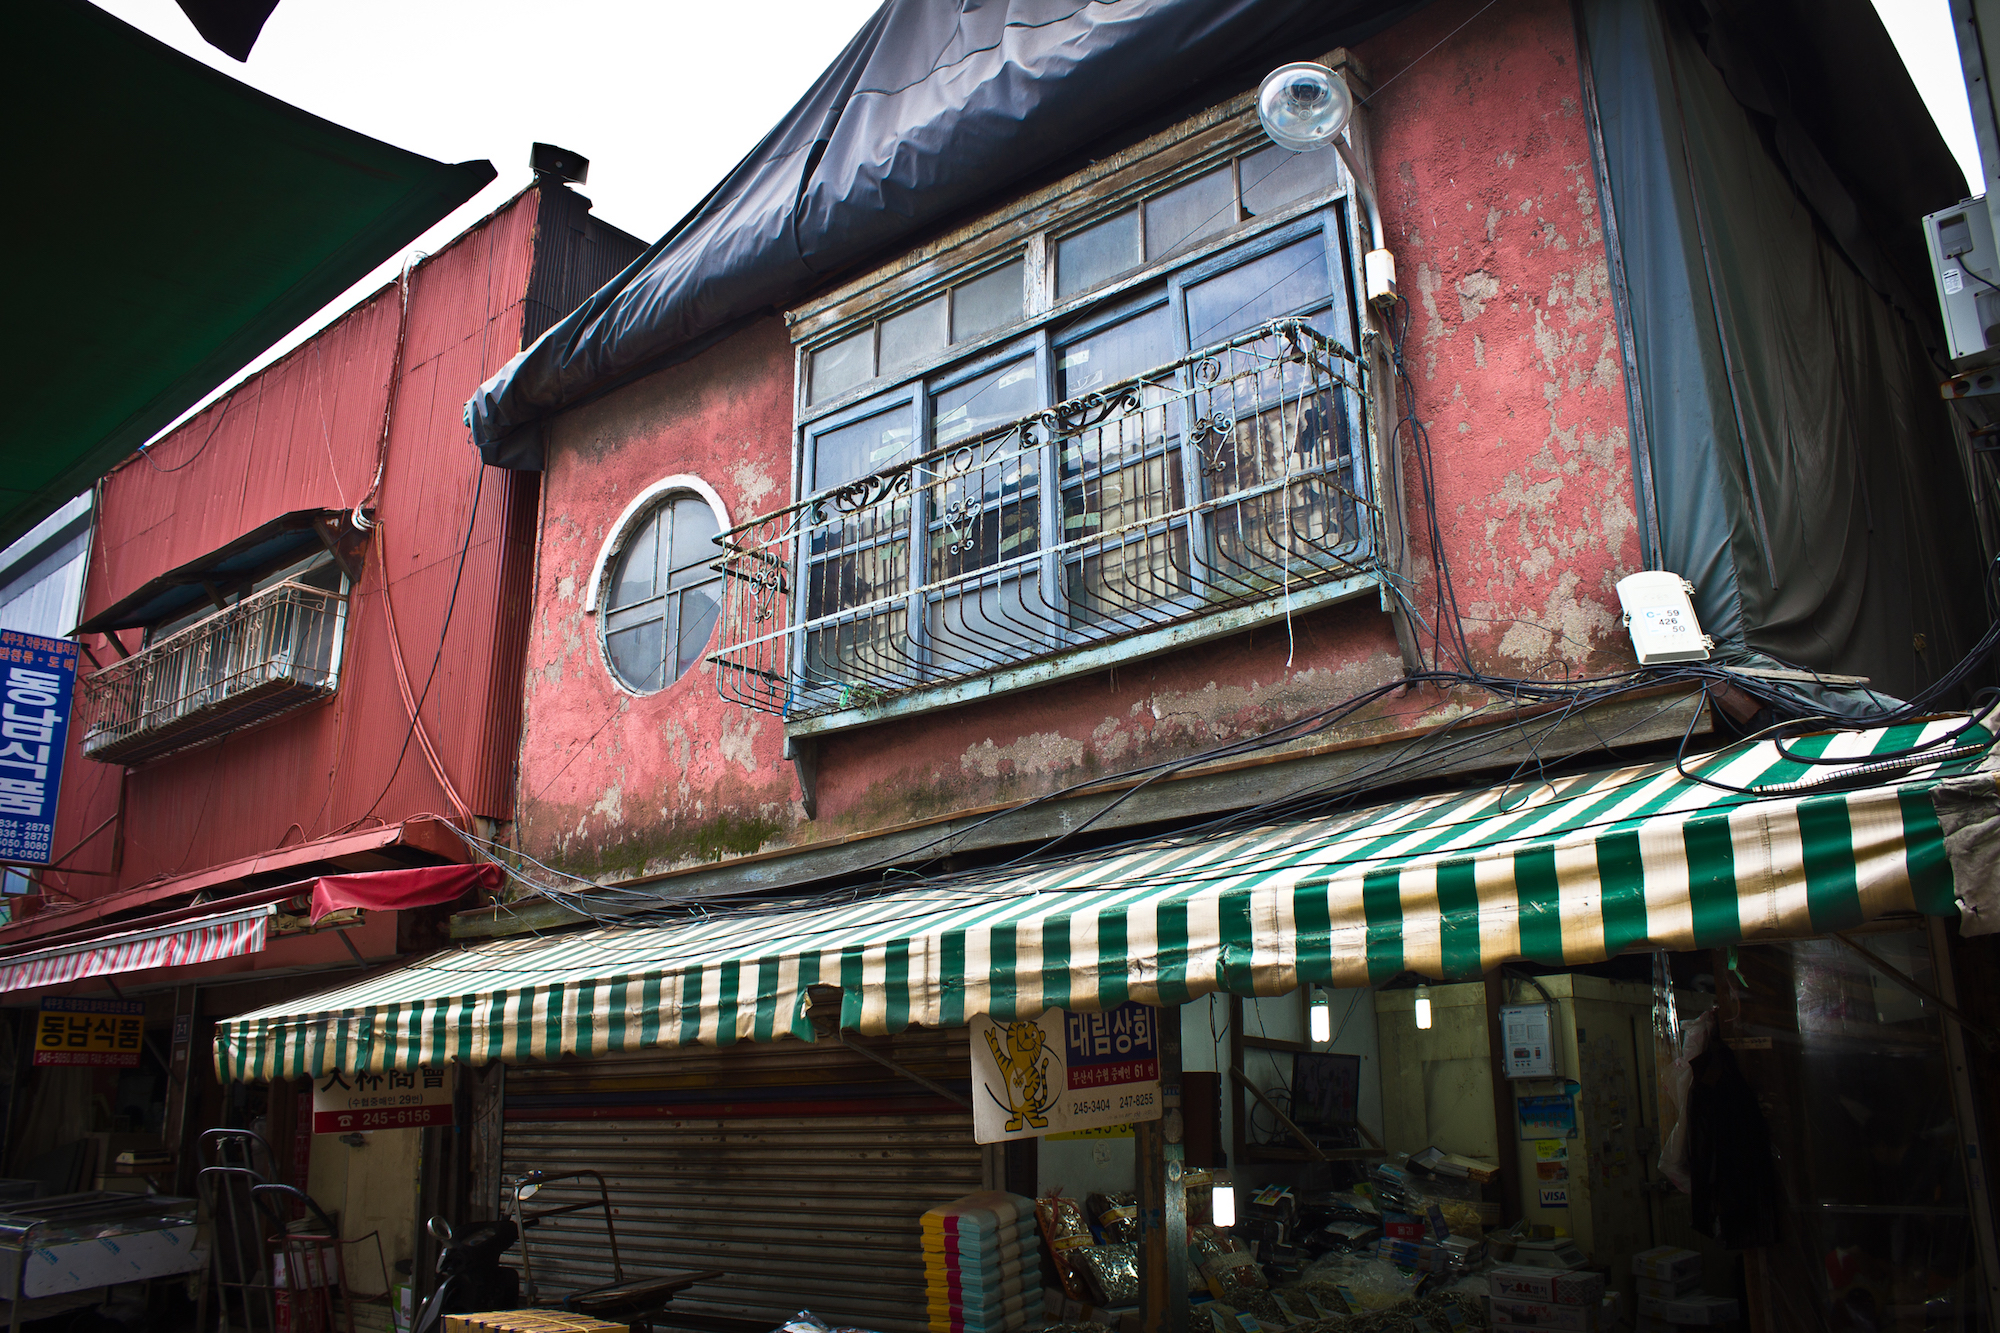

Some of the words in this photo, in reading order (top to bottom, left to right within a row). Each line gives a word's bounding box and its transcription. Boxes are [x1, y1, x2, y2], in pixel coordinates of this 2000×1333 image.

[1659, 618, 1678, 626] 426
[1667, 609, 1680, 617] 59
[1672, 625, 1686, 633] 50
[0, 667, 62, 816] 동남식품
[42, 1016, 141, 1049] 동남식품
[1069, 1006, 1152, 1057] 대림상회
[1072, 1069, 1094, 1085] 부산시
[1095, 1067, 1110, 1083] 수협
[1134, 1063, 1144, 1078] 61
[1147, 1062, 1155, 1077] 번
[1074, 1098, 1110, 1115] 245-3404
[1119, 1093, 1154, 1109] 247-8255
[363, 1109, 431, 1125] 245-6156
[1543, 1191, 1567, 1201] VISA
